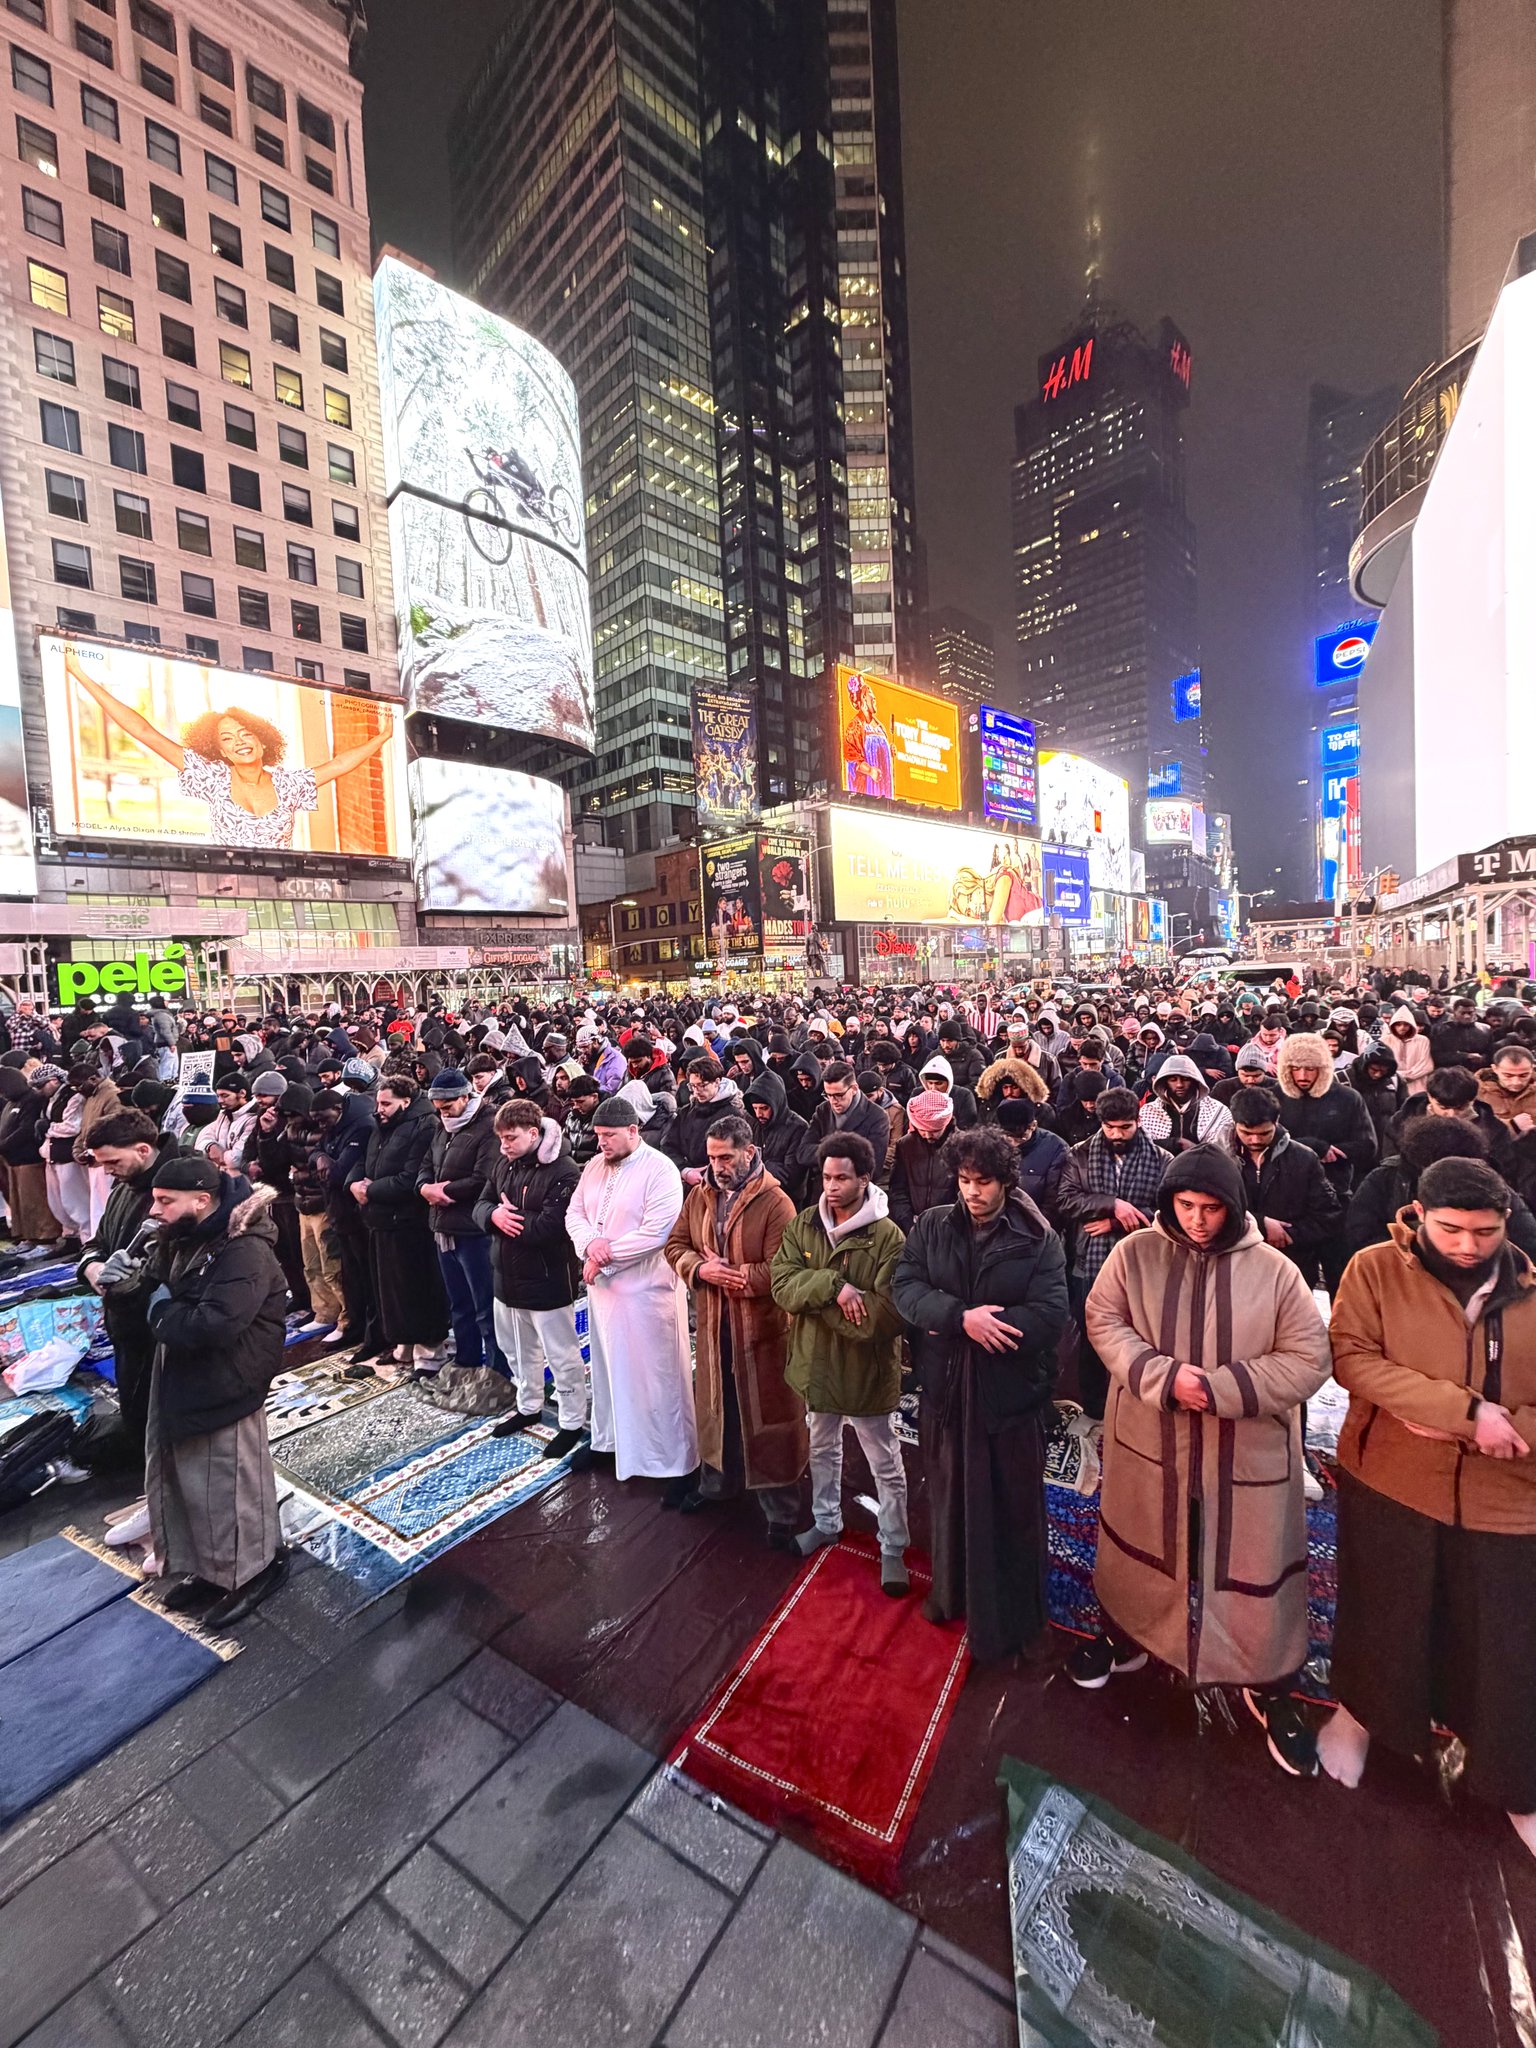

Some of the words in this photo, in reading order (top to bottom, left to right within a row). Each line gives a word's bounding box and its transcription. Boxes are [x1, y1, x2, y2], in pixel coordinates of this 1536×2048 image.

[1043, 338, 1093, 403] H&M
[50, 644, 104, 661] ALPHERO
[1335, 646, 1366, 659] PEPSI
[698, 708, 716, 723] THE
[717, 712, 750, 729] GREAT
[705, 723, 745, 739] GATSBY
[1327, 733, 1343, 742] TO
[71, 821, 103, 830] MODEL
[109, 824, 131, 833] Alysa
[132, 826, 155, 834] Dixon
[762, 844, 782, 856] WORLD
[717, 862, 730, 871] two
[847, 854, 882, 878] TELL
[886, 859, 909, 880] ME
[912, 863, 941, 883] LIES
[715, 867, 747, 881] strangers
[886, 896, 910, 909] hulu
[480, 931, 533, 945] EXPRESS
[731, 937, 743, 947] THE
[744, 935, 759, 946] YEAR
[695, 961, 713, 969] GIFTS
[57, 943, 186, 1006] pelé
